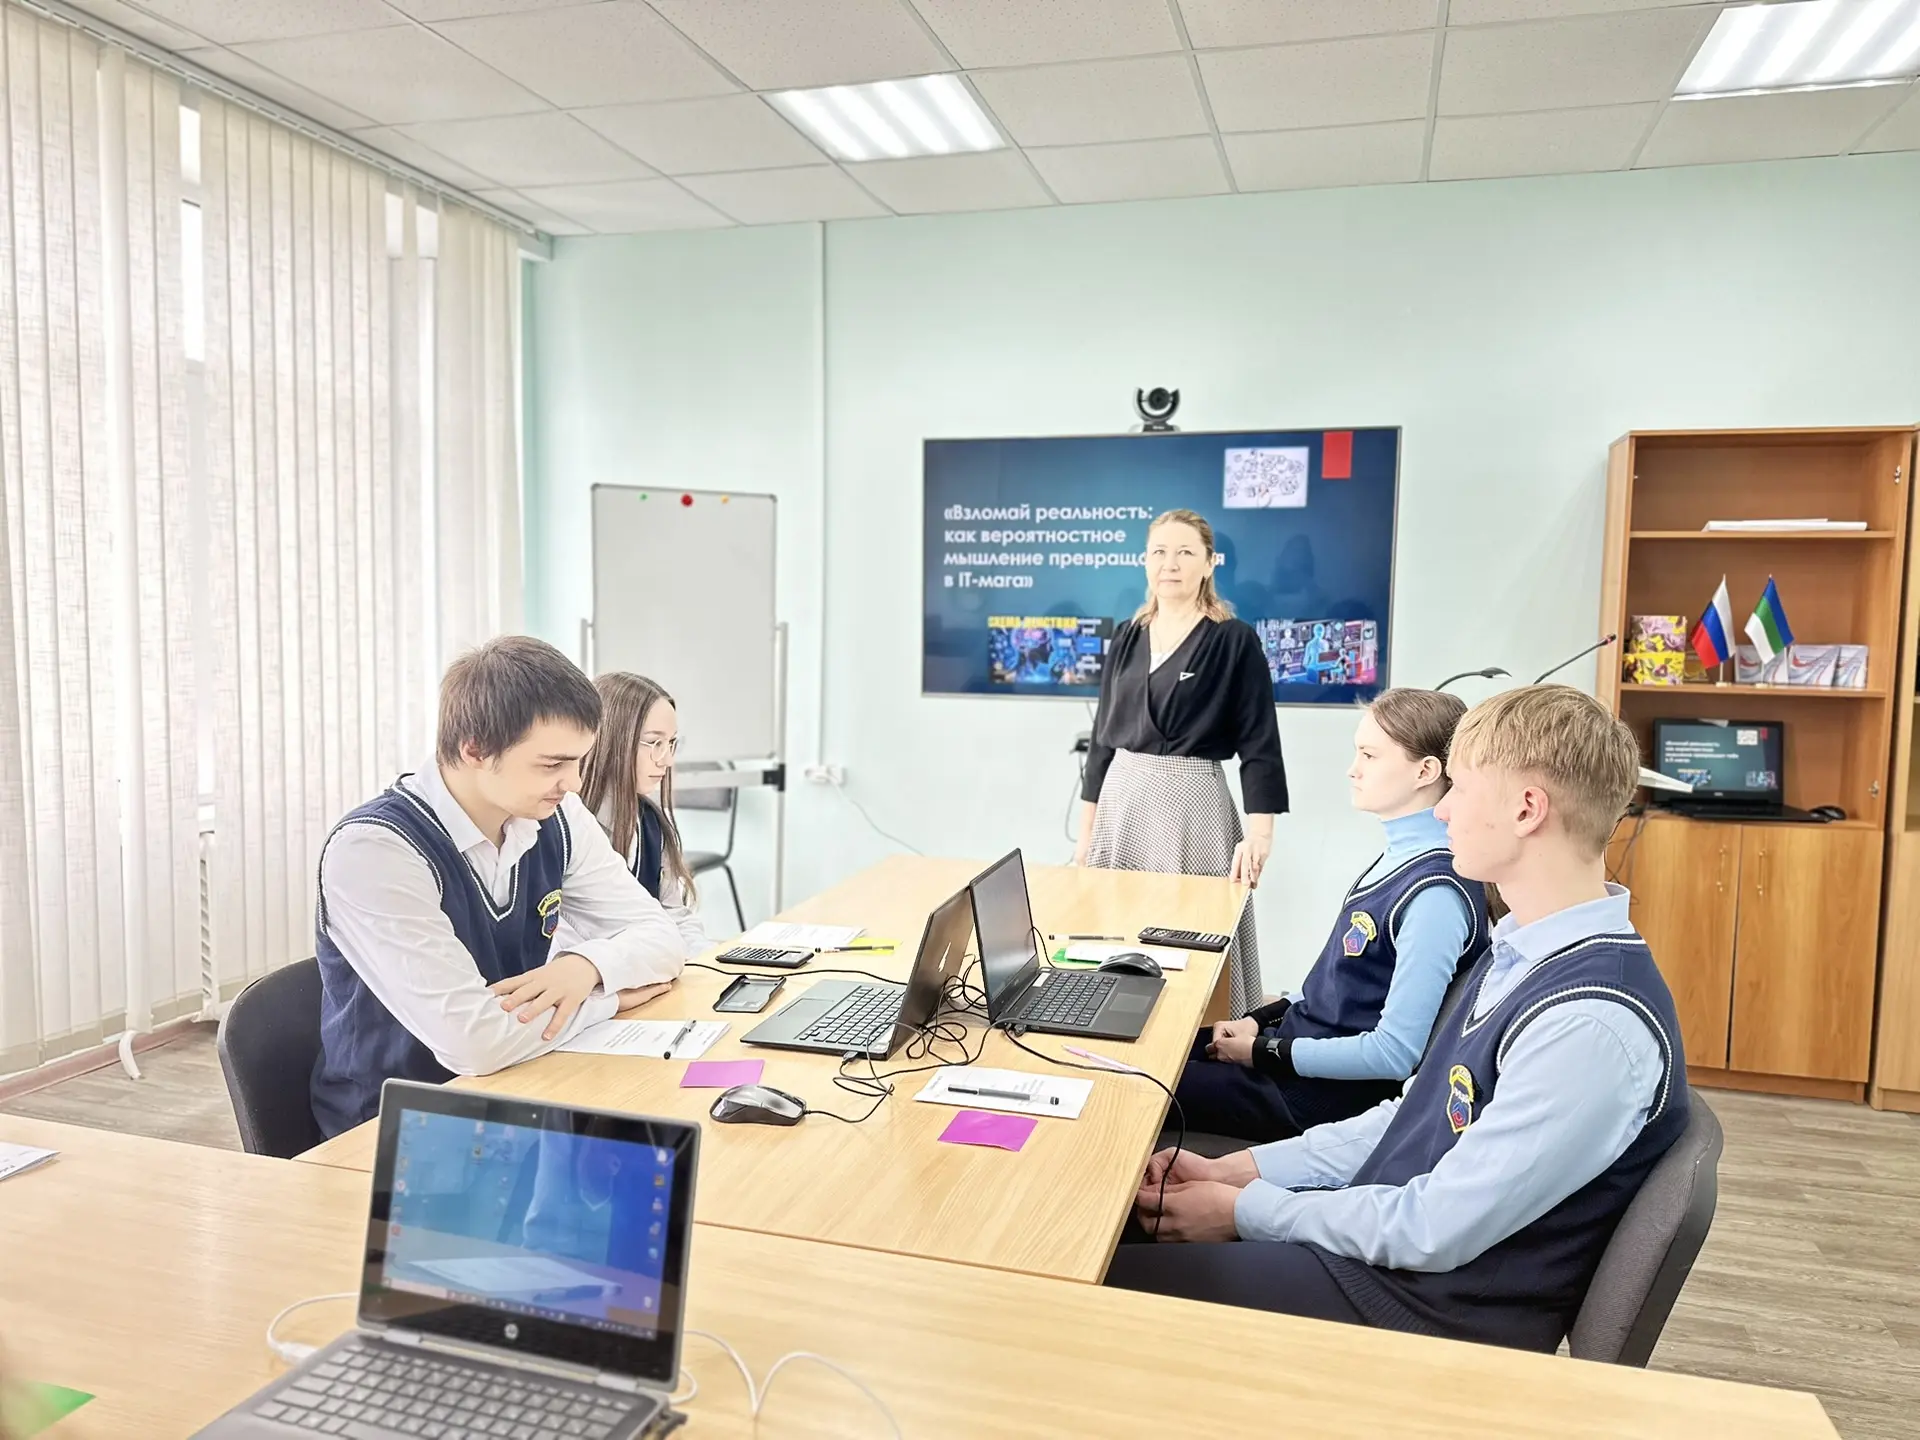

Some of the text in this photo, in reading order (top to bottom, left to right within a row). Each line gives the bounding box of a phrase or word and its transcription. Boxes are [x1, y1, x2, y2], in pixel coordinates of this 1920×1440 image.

[943, 503, 1153, 524] «Взломай реальность:
[944, 528, 1127, 547] как вероятностное
[943, 551, 1147, 569] мышление превраща
[943, 571, 1034, 589] в IT-мага»
